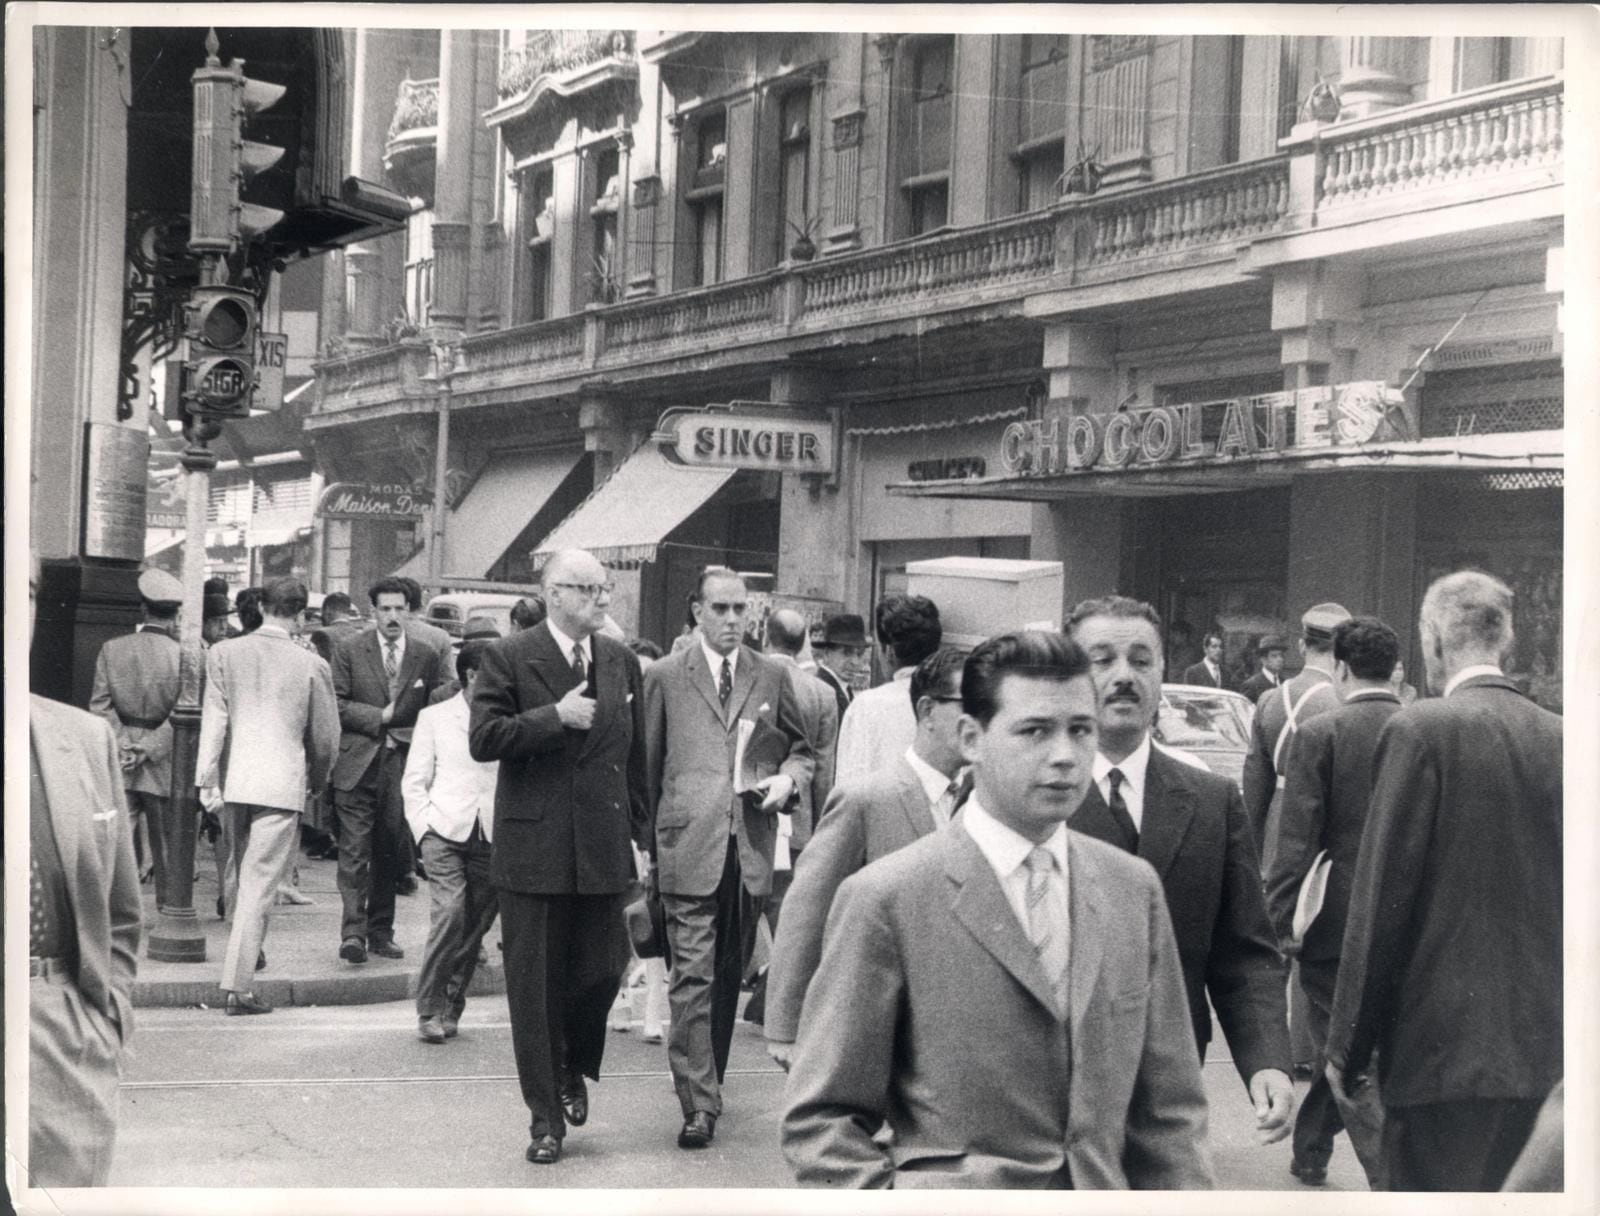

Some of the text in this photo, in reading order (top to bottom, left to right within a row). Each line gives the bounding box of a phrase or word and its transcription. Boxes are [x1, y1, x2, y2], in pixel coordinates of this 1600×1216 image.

[258, 339, 285, 368] XIS
[201, 371, 243, 394] SIGA
[1000, 383, 1386, 475] CHOCOLATES
[694, 426, 822, 461] SINGER
[369, 484, 423, 495] MODAS
[328, 493, 391, 513] Maison
